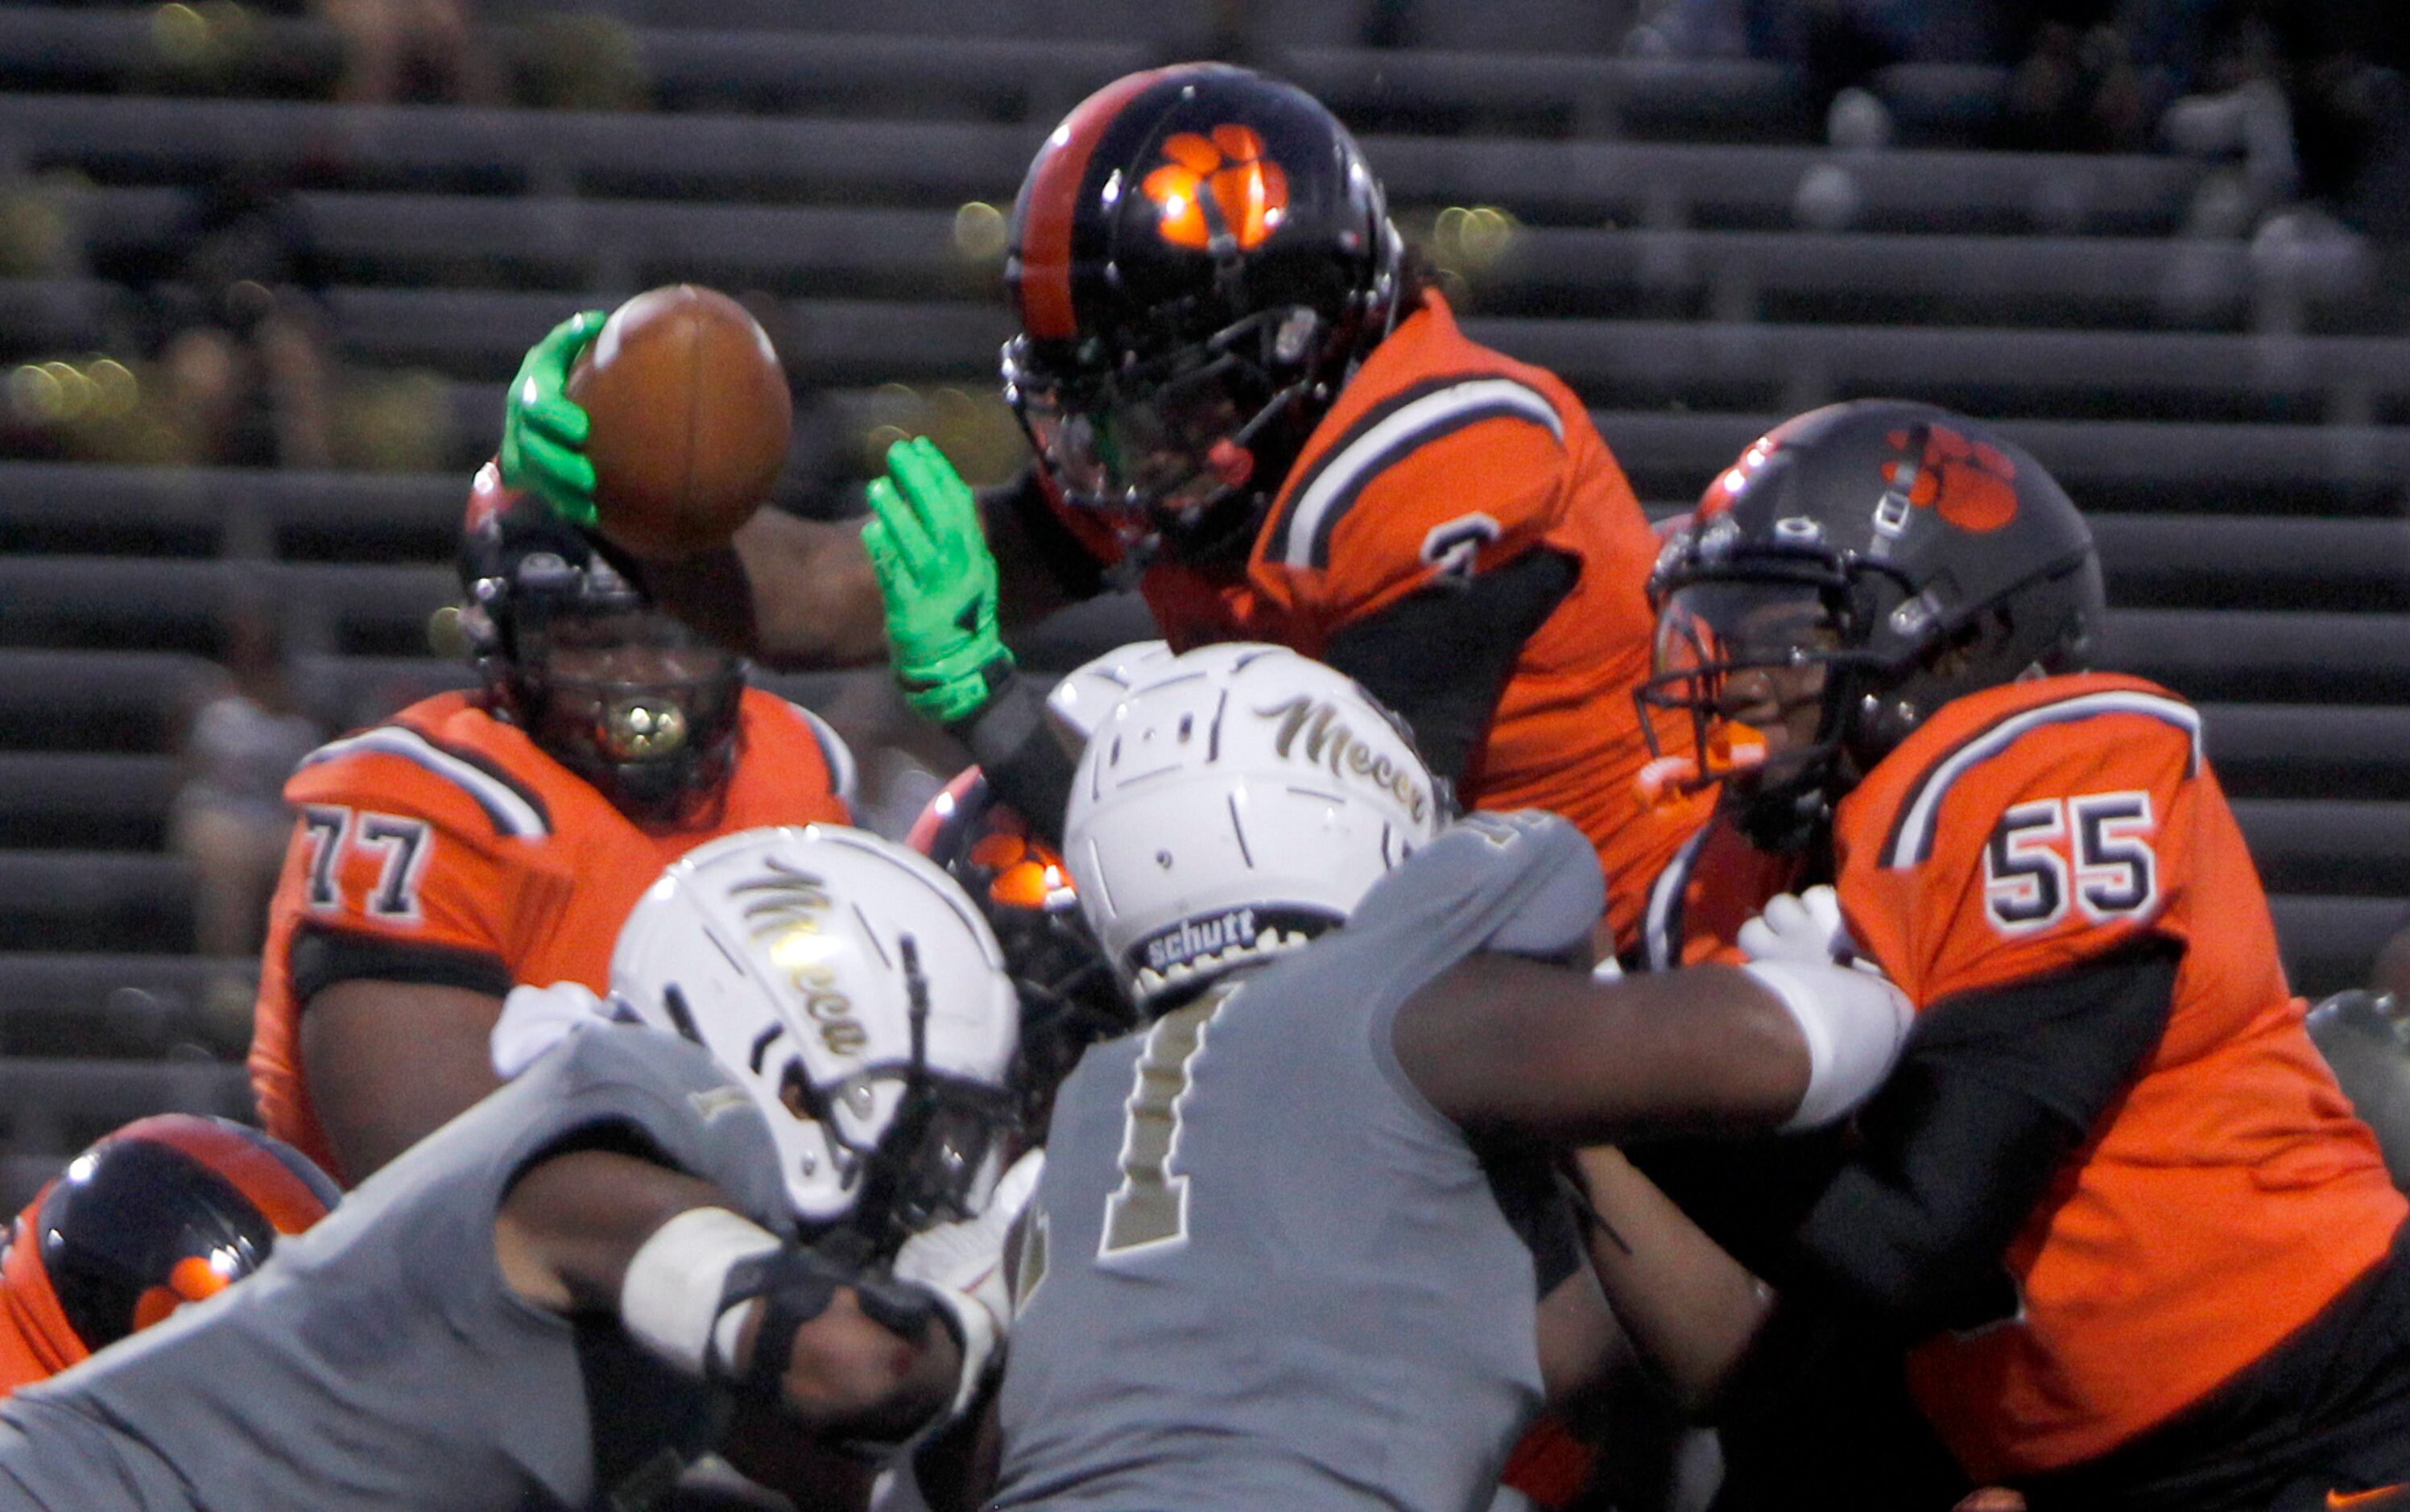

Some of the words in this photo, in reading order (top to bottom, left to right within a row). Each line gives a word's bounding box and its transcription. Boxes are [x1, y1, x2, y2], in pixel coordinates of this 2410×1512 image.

[303, 803, 433, 919] 77
[1983, 789, 2163, 937] 55
[727, 853, 869, 1057] Mcca
[1147, 907, 1256, 973] schutt
